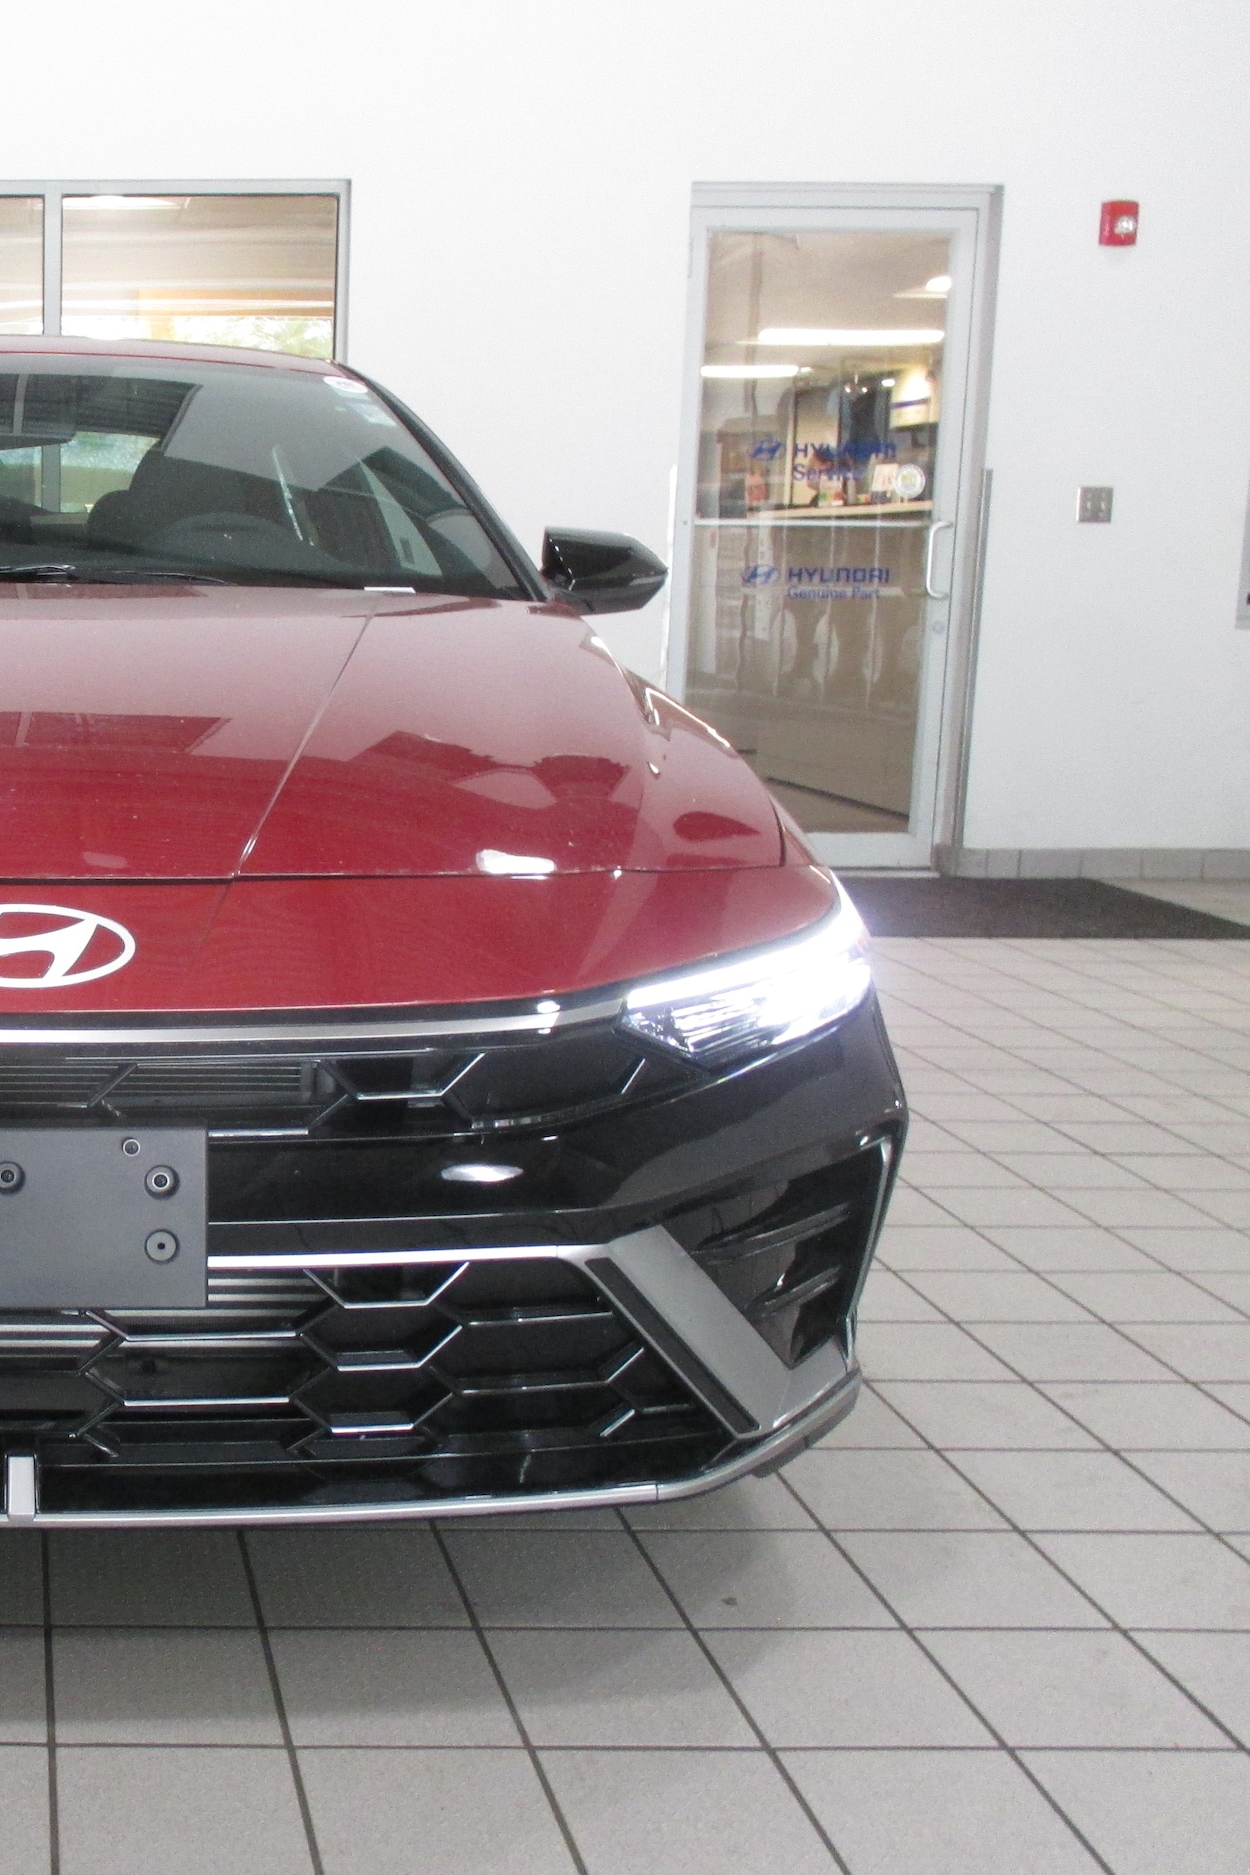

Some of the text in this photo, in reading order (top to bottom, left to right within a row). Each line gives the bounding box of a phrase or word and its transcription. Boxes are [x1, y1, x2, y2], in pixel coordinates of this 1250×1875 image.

[794, 442, 897, 459] HYUAI
[788, 567, 890, 583] HYUNDAI
[787, 584, 847, 600] Genuine
